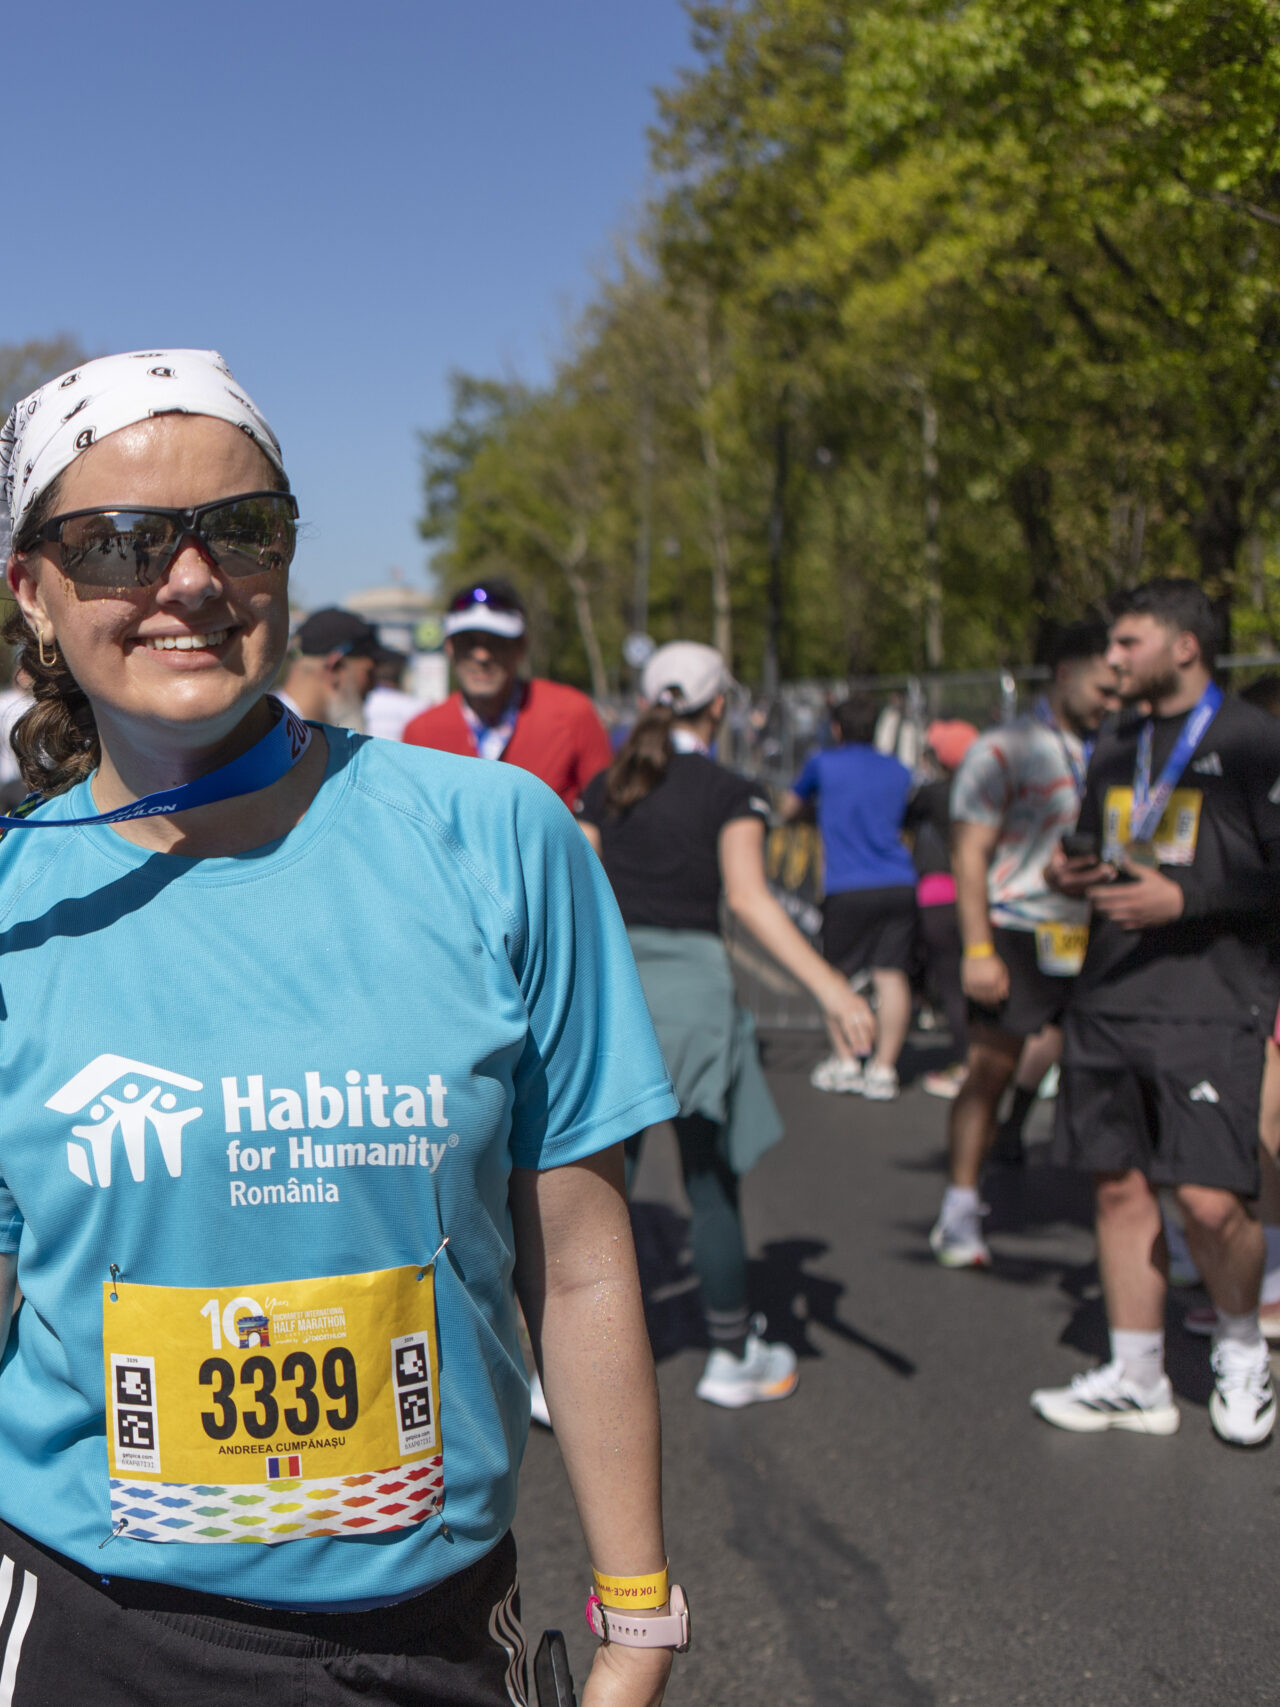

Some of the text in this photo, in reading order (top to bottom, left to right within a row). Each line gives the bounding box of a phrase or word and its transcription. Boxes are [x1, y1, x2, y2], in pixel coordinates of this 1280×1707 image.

[221, 1069, 449, 1133] Habitat
[226, 1139, 276, 1172] for
[229, 1177, 339, 1206] România
[273, 1320, 297, 1333] HALF
[297, 1315, 346, 1331] MARATHON
[199, 1347, 359, 1440] 3339
[218, 1444, 273, 1455] ANDREEA
[640, 1586, 657, 1596] 10K
